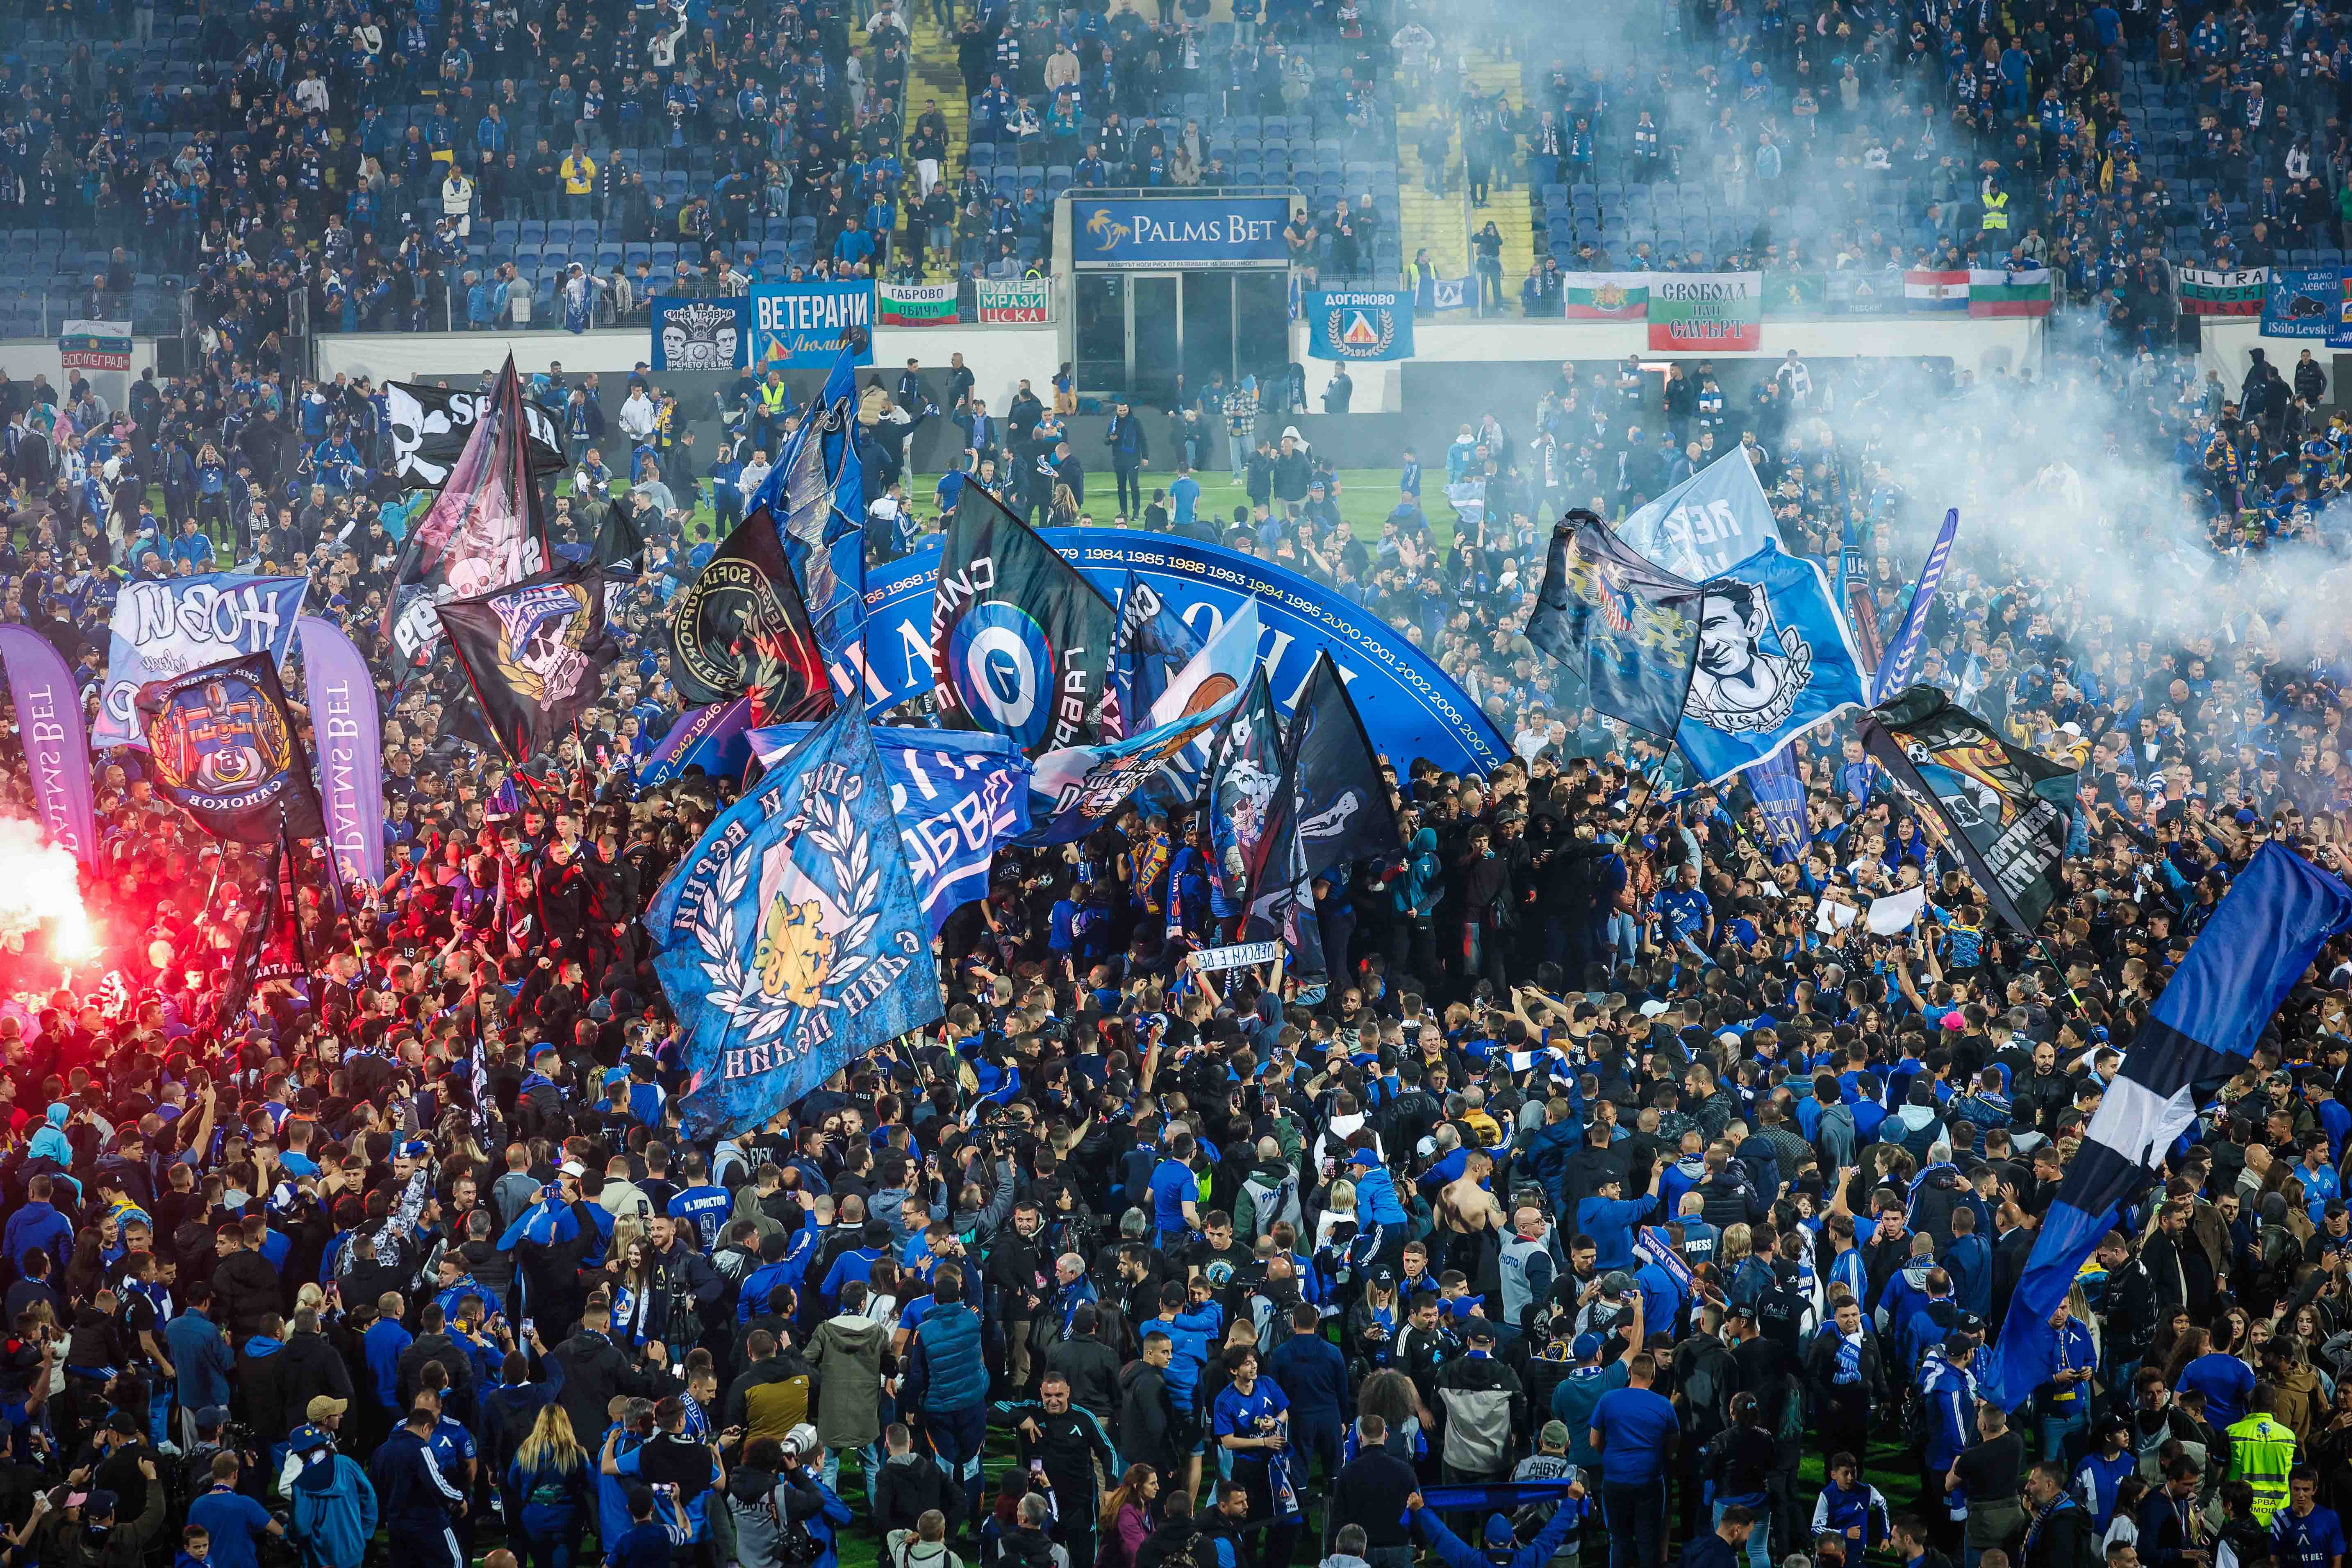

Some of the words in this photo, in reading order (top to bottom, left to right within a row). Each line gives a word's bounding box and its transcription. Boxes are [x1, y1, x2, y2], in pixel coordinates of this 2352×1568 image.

[1132, 215, 1221, 244] PALMS
[1226, 215, 1277, 243] BET
[2184, 270, 2263, 285] ULTRA
[891, 288, 944, 299] ГАБРОВО
[1324, 293, 1395, 306] ДОГАНОВО
[1662, 283, 1748, 303] СВОБОДА
[2183, 287, 2263, 300] LEVSKI
[983, 294, 1044, 308] МРАЗИ
[1848, 302, 1883, 312] ЛЕВСКИ!
[2186, 301, 2263, 314] HISAR
[666, 311, 691, 319] СИНЯ
[696, 309, 734, 319] ТРЯВНА
[758, 291, 868, 330] ВЕТЕРАНИ
[898, 305, 939, 317] ОБИЧА
[1670, 319, 1745, 339] СМЪРТ
[2296, 323, 2334, 335] Levski!
[1350, 348, 1373, 357] 1914
[62, 352, 123, 368] БОСИЛЕГРАД
[666, 360, 702, 369] ВРЕМЕТО
[666, 733, 696, 768] 1942
[691, 704, 722, 737] 1946
[867, 589, 886, 604] 65
[885, 574, 924, 595] 1968
[926, 568, 939, 582] 19
[1084, 548, 1123, 561] 1984
[1126, 550, 1165, 566] 1985
[1167, 555, 1206, 574] 1988
[1207, 565, 1246, 586] 1993
[1246, 577, 1284, 601] 1994
[1284, 593, 1322, 618] 1995
[1321, 612, 1361, 641] 2000
[1359, 636, 1396, 667] 2001
[1395, 662, 1432, 695] 2002
[1427, 691, 1463, 726] 2006
[1458, 723, 1493, 758] 2007
[1764, 718, 1782, 734] 2016
[1982, 799, 2058, 875] ROTHERS
[999, 865, 1020, 877] ULTRA
[403, 947, 414, 958] 18
[1261, 1182, 1295, 1204] PHOO
[693, 1195, 726, 1209] ХРИСТОВ
[700, 1213, 717, 1247] 9
[1686, 1239, 1712, 1253] PRESS
[1500, 1252, 1519, 1268] PHOTO
[2311, 1552, 2323, 1561] BET
